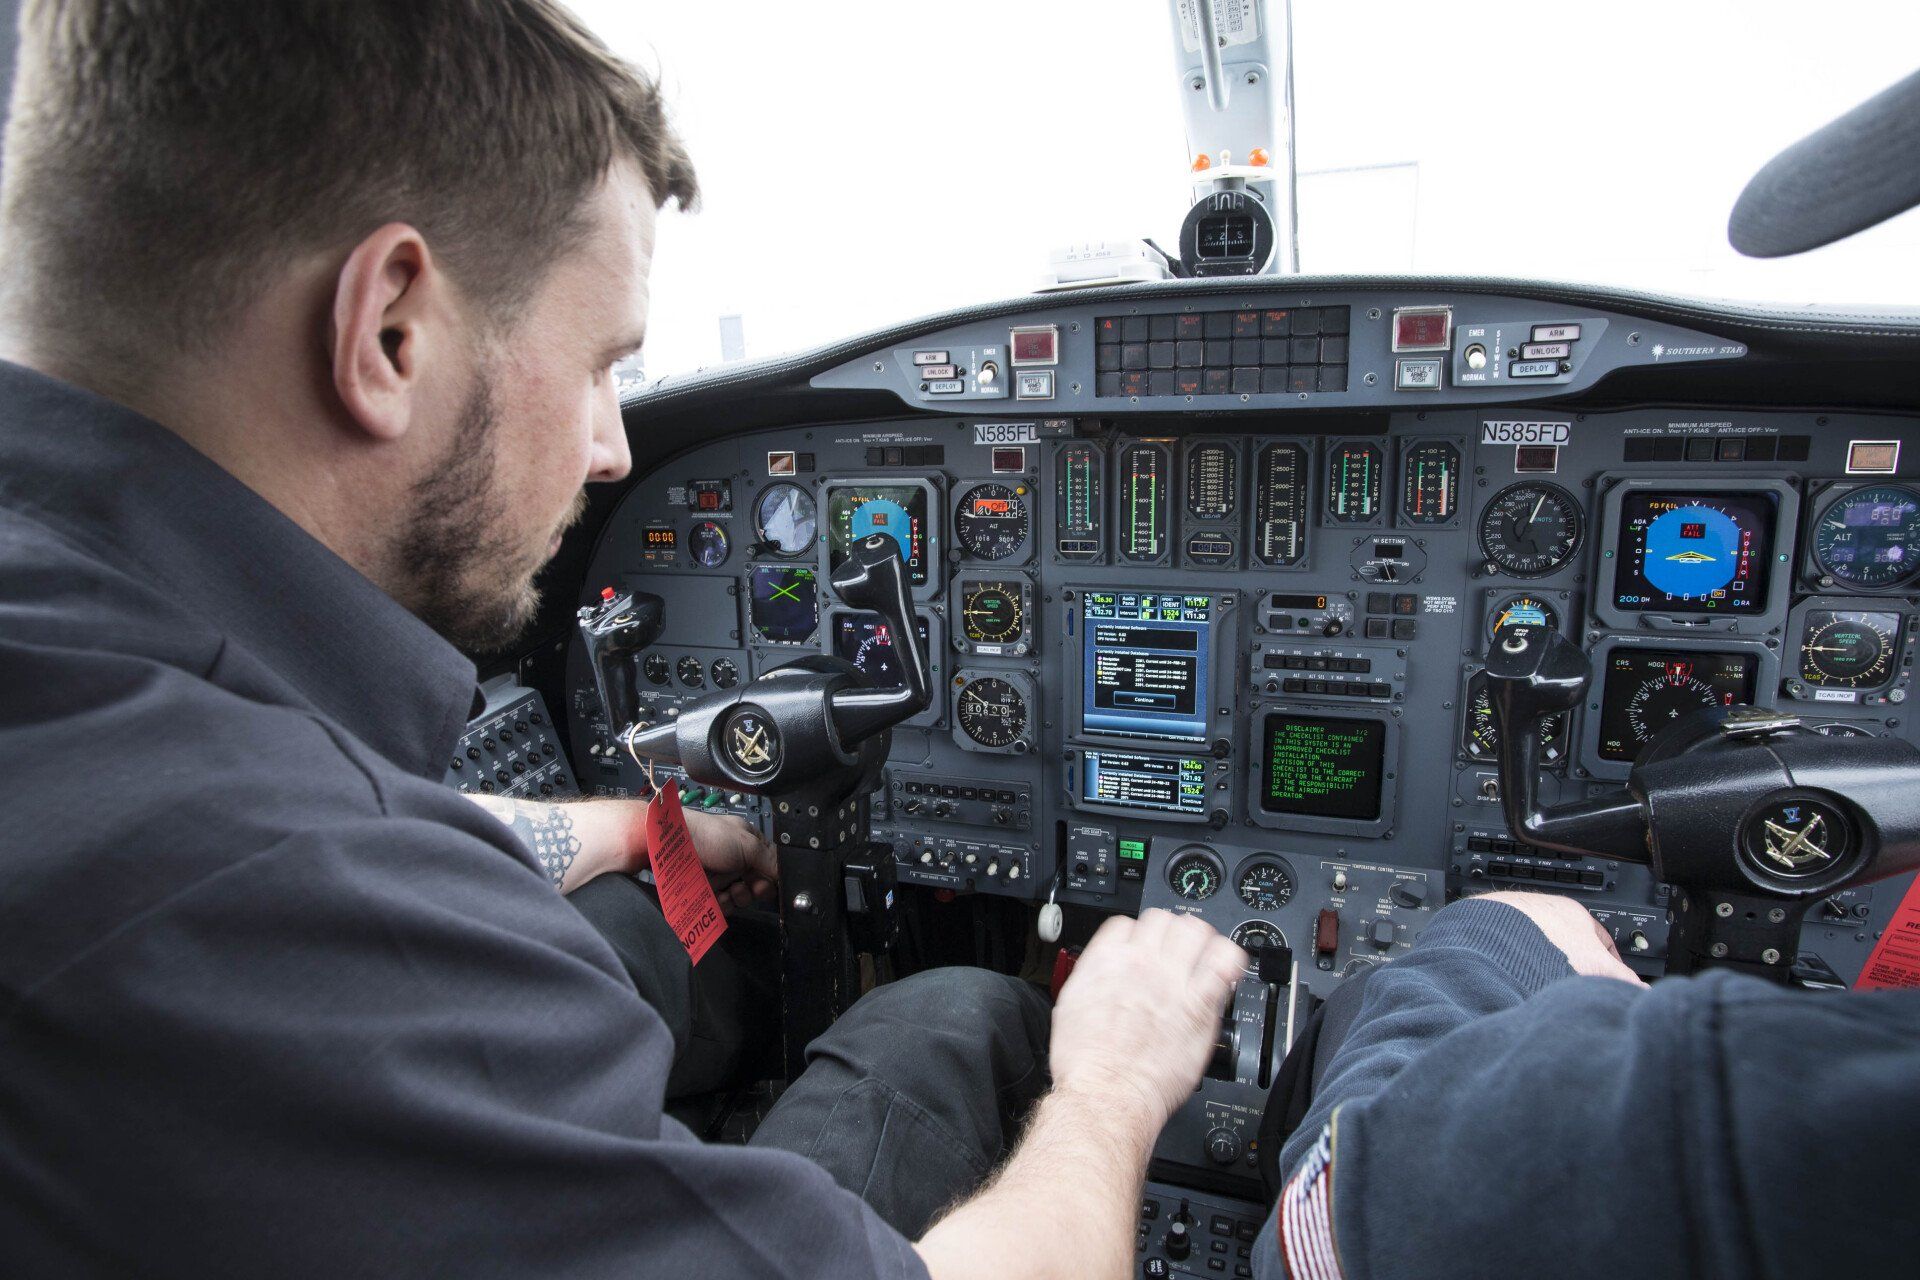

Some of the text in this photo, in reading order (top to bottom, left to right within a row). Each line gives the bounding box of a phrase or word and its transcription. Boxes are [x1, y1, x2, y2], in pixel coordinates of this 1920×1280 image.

[1468, 329, 1485, 337] EMER
[1549, 329, 1565, 337] ARM
[1531, 347, 1560, 355] UNLOCK
[1666, 346, 1744, 355] SOUTHERN STAR
[1519, 365, 1549, 373] DEPLOY
[1482, 423, 1570, 443] N585FD
[991, 503, 1007, 511] OFF
[1317, 597, 1325, 608] 0
[1286, 725, 1324, 733] DISCLAIMER
[1290, 732, 1324, 740] CHECKLIST
[1328, 735, 1364, 743] CONTAINED
[1274, 745, 1351, 756] UNAPPROVED CHECKLIST
[1274, 751, 1321, 760] INSTALLATION.
[1274, 758, 1304, 766] REVISION
[1273, 765, 1307, 773] CHECKLIST
[1298, 780, 1354, 789] RESPONSIBILITY
[1272, 791, 1305, 799] OPERATOR.
[1232, 1104, 1247, 1113] ENGINE
